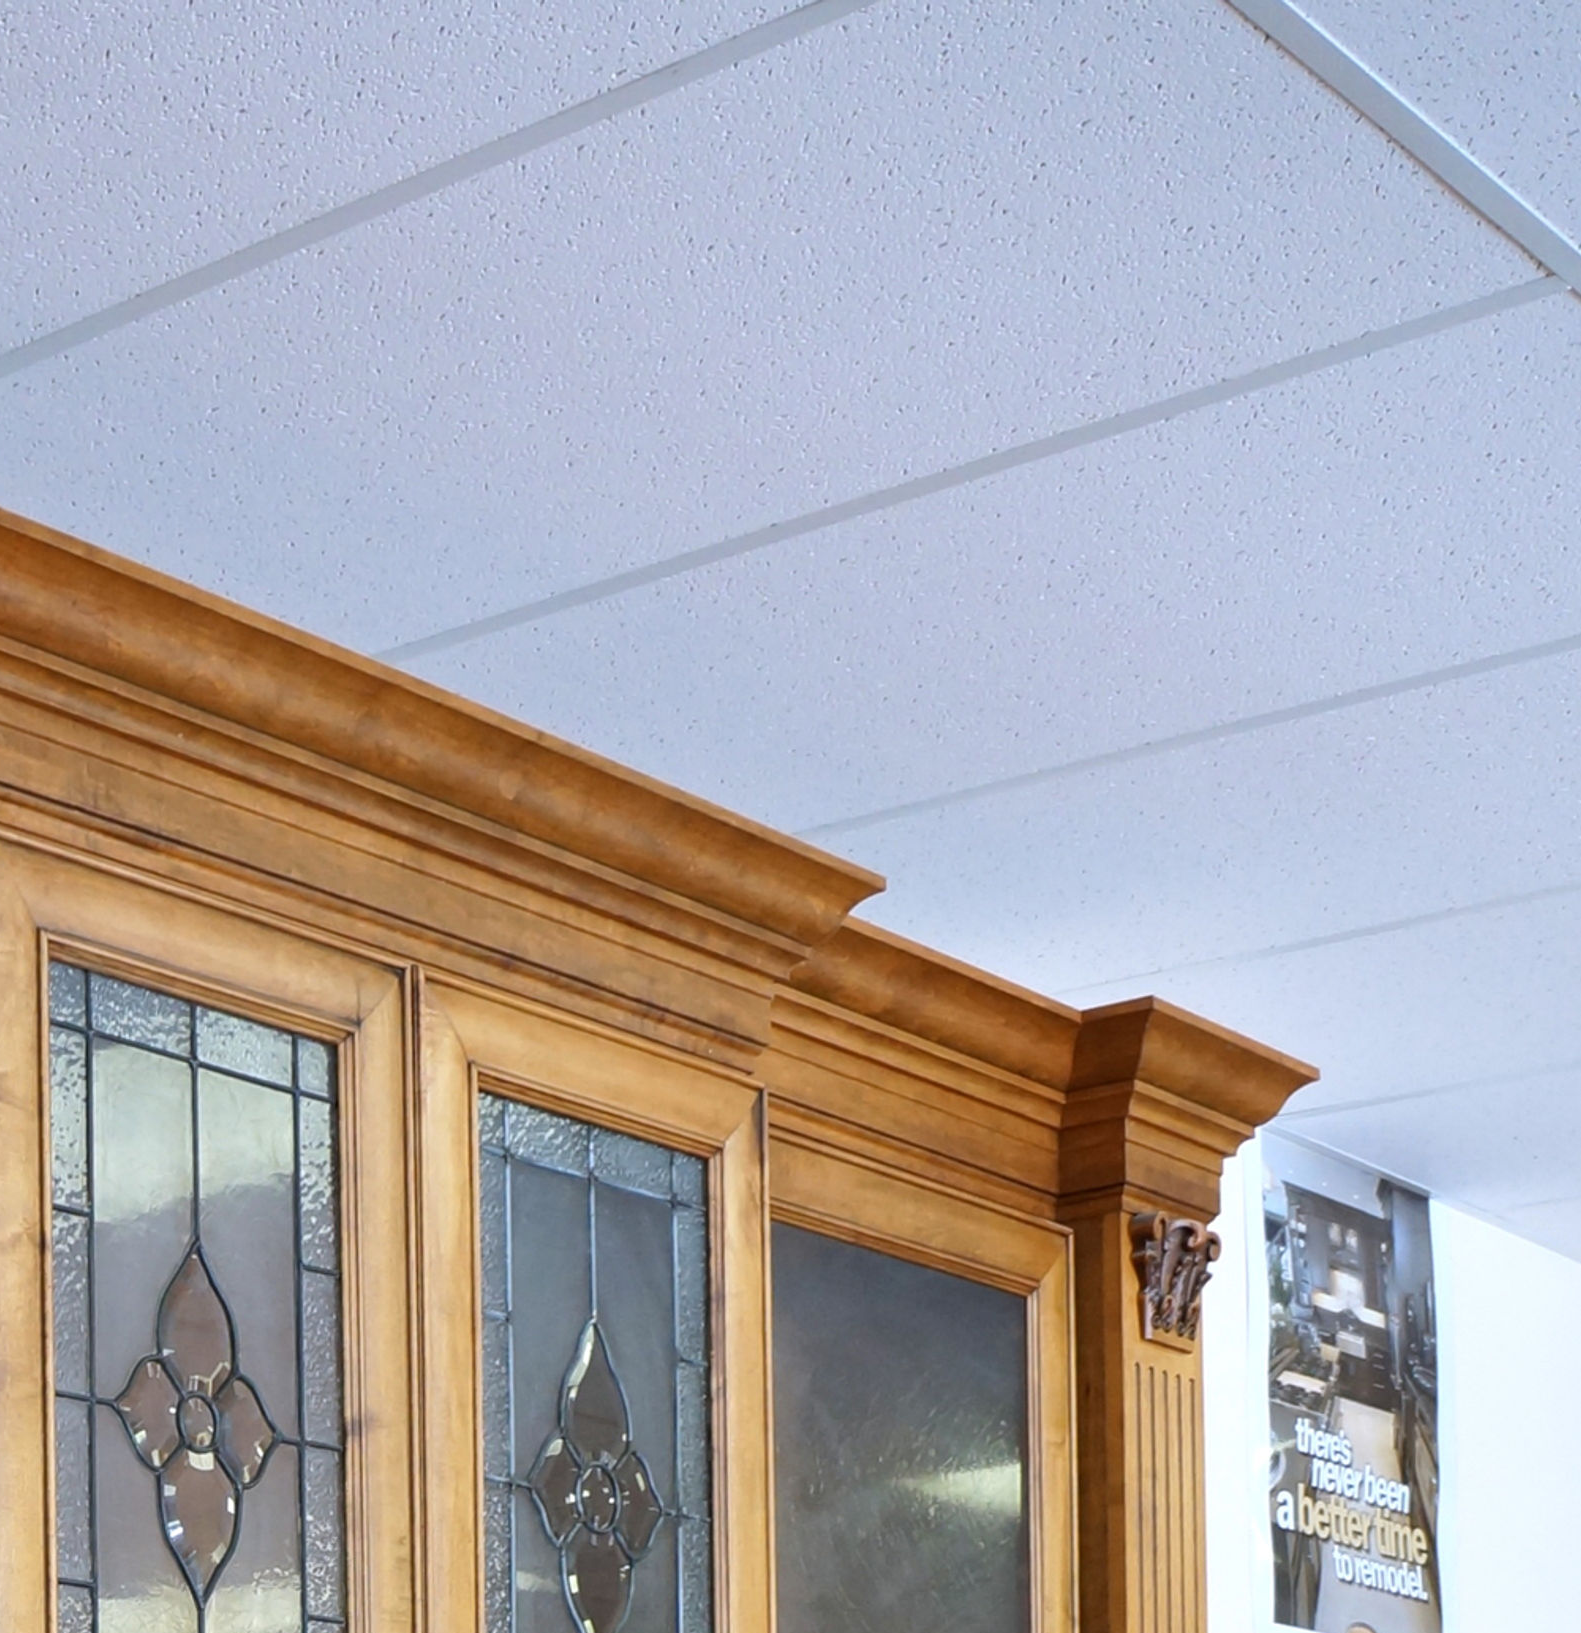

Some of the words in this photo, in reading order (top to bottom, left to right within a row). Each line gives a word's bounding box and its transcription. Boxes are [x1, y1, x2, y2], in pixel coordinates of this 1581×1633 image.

[1295, 1417, 1352, 1466] there's
[1311, 1456, 1363, 1500] never
[1364, 1464, 1410, 1514] been
[1276, 1490, 1295, 1532] a
[1297, 1483, 1371, 1551] better
[1372, 1508, 1428, 1566] time
[1333, 1544, 1354, 1582] to
